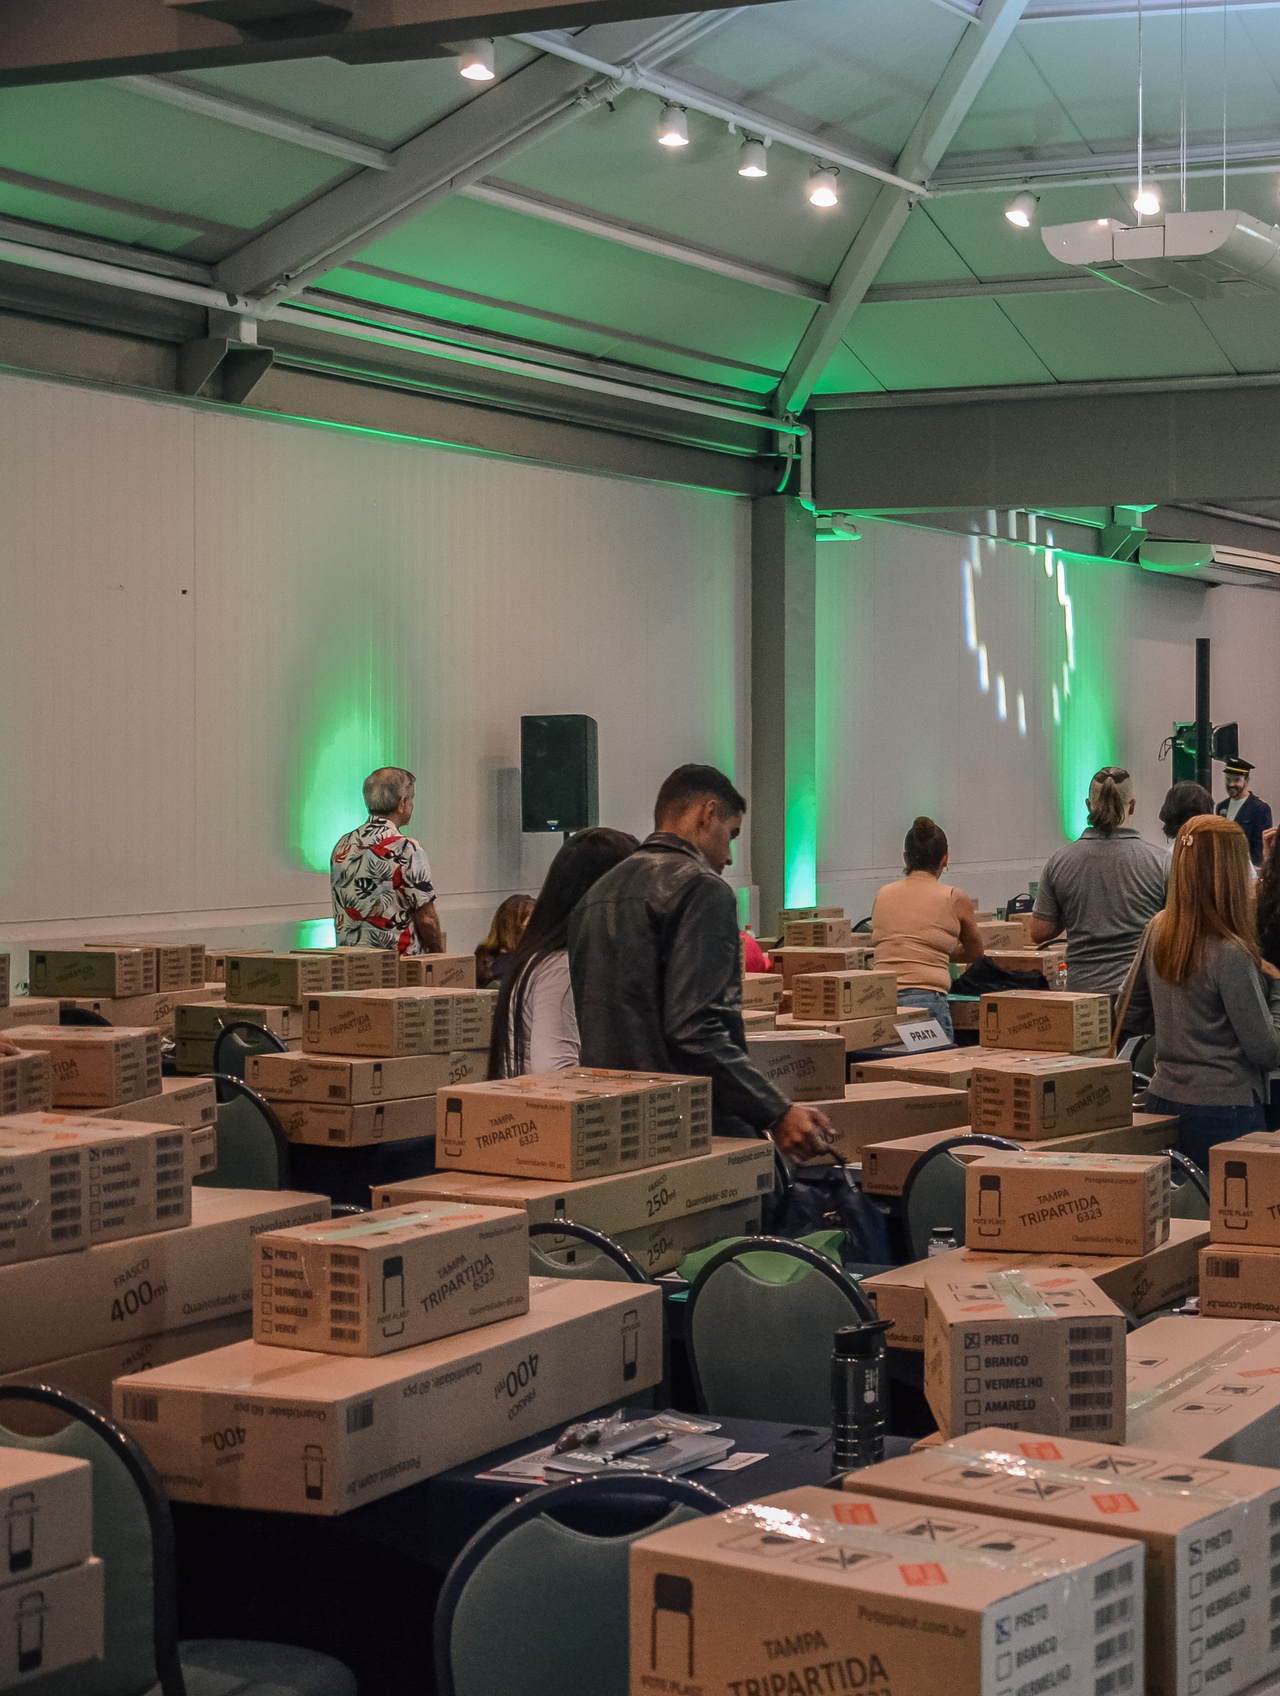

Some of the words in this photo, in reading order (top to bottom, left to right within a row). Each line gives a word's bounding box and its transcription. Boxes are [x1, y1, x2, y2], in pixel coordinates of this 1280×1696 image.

[1007, 1016, 1050, 1034] TRIPARTIDA
[910, 1029, 937, 1042] PRATA
[489, 1113, 515, 1127] TAMPA
[475, 1119, 538, 1150] TRIPARTIDA
[519, 1133, 540, 1147] 6323
[646, 1188, 676, 1218] 250ml
[1037, 1189, 1069, 1204] TAMPA
[1018, 1195, 1099, 1227] TRIPARTIDA
[1077, 1208, 1103, 1223] 6323
[113, 1258, 149, 1287] FRASCO
[436, 1254, 467, 1279] TAMPA
[420, 1254, 494, 1313] TRIPARTIDA
[473, 1268, 495, 1291] 6323
[111, 1280, 168, 1322] 400ml
[1206, 1300, 1279, 1313] Poteplast.com.br
[985, 1334, 1019, 1345] PRETO
[985, 1356, 1028, 1368] BRANCO
[494, 1353, 539, 1399] 400ml
[985, 1377, 1043, 1390] VERMELHO
[985, 1400, 1035, 1412] AMARELO
[764, 1630, 828, 1661] TAMPA
[727, 1653, 889, 1696] TRIPARTIDA
